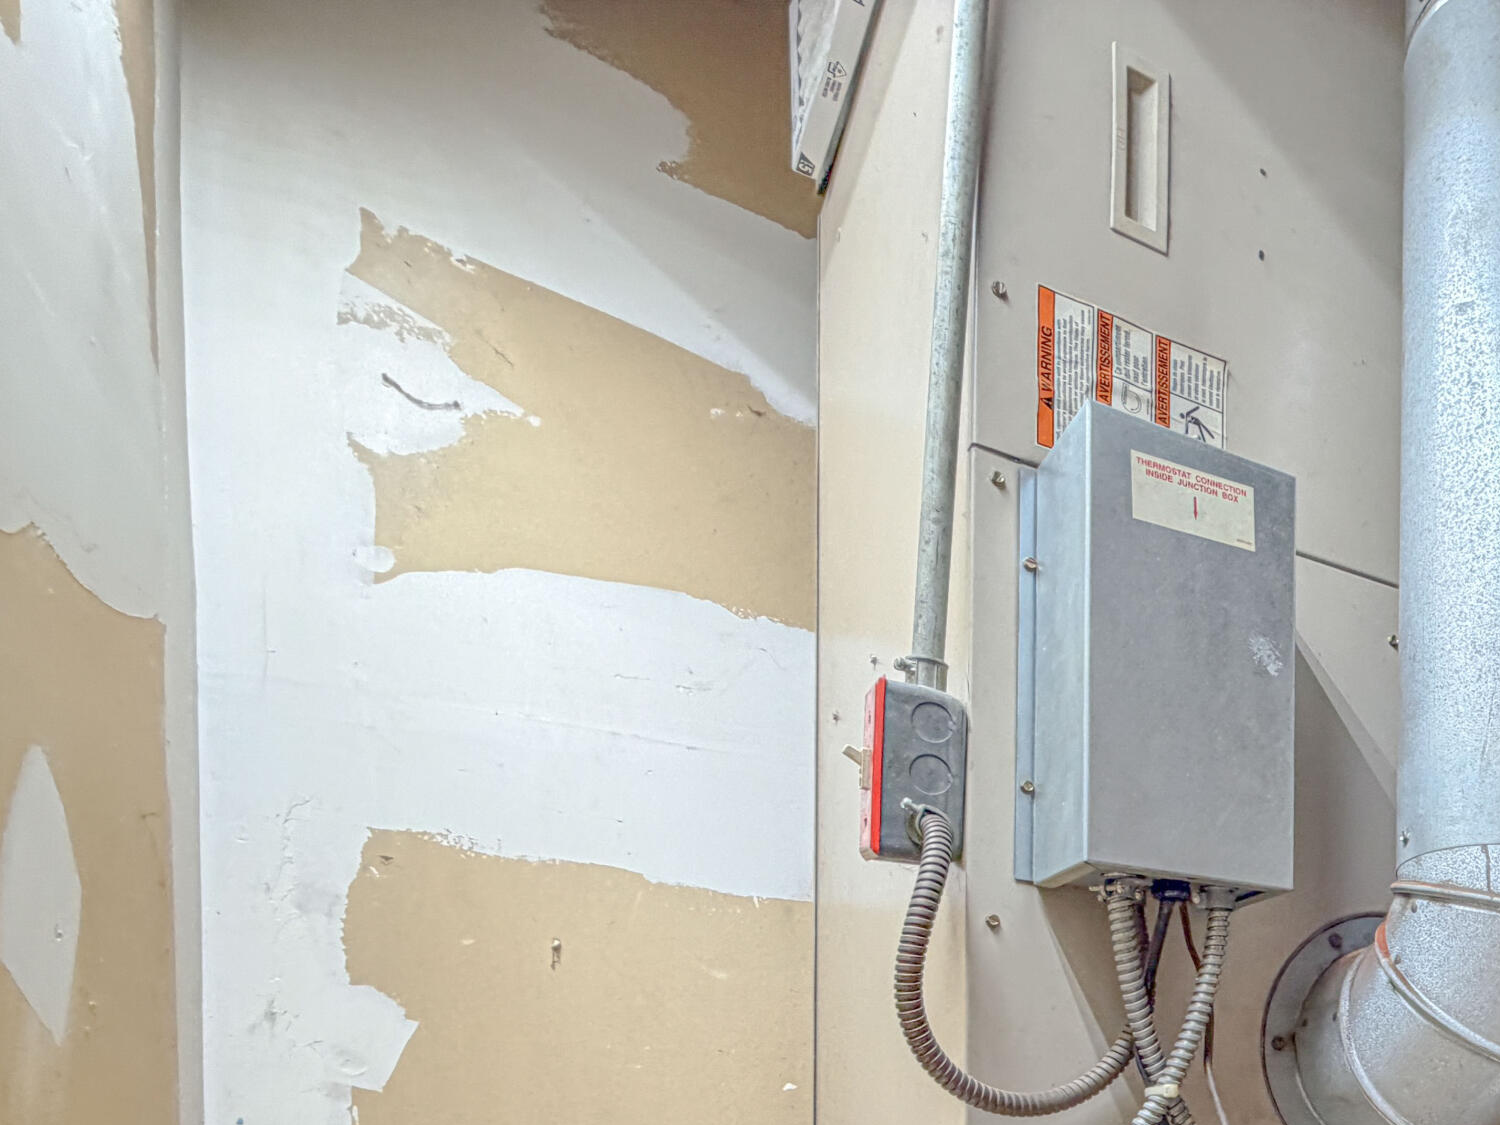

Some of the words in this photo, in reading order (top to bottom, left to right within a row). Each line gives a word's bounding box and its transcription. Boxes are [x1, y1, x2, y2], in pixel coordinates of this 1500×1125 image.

[1099, 313, 1111, 403] AVERTISSEMENT
[1158, 340, 1168, 424] AVERTISSEMENT
[1136, 456, 1192, 479] THERMOSTAT
[1195, 475, 1247, 497] CONNECTION
[1145, 468, 1173, 483] INSIDE
[1177, 478, 1218, 497] JUNCTION
[1221, 491, 1239, 503] BOX
